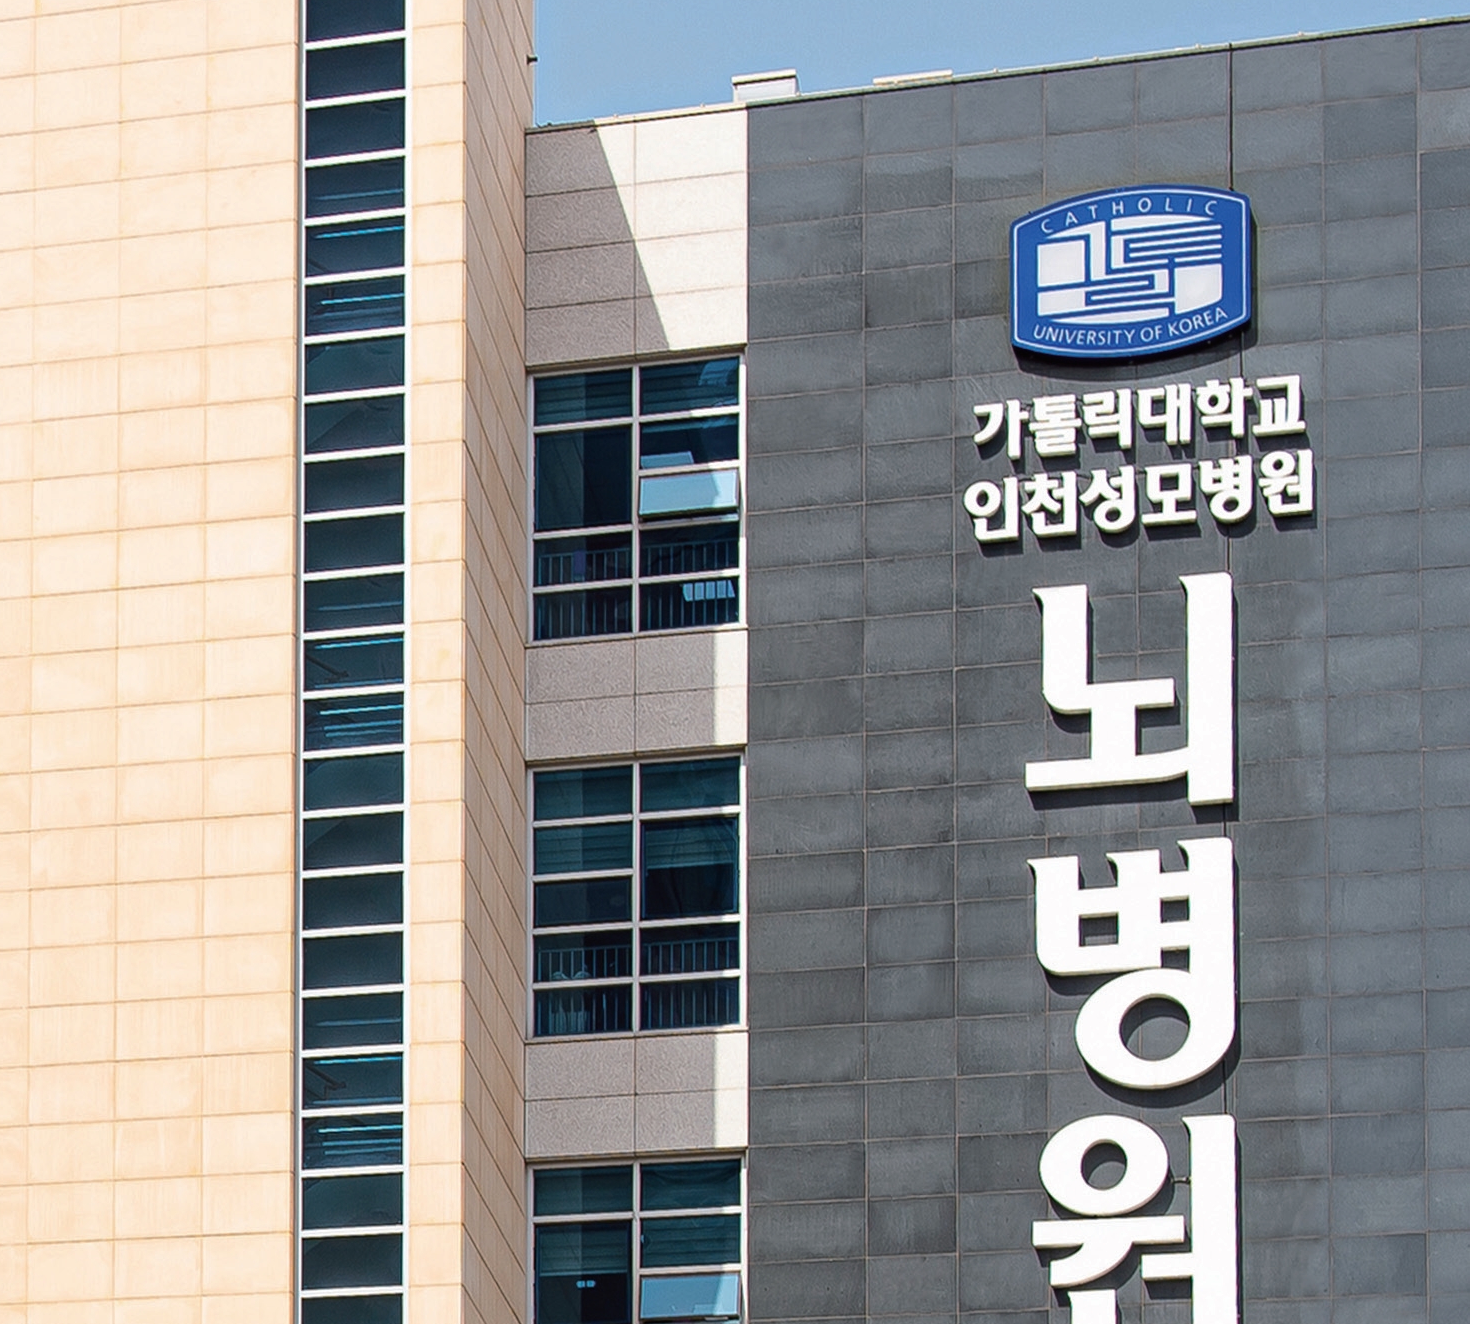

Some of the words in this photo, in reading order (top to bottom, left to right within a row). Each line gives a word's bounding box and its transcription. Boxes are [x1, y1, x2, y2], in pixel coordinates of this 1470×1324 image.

[1041, 197, 1218, 235] CATHOLIC
[1033, 324, 1136, 347] UNIVERSITY
[1140, 324, 1163, 344] OF
[1168, 306, 1229, 337] KOREA
[973, 375, 1306, 461] 가톨릭대학교
[963, 449, 1315, 544] 인천성모병원
